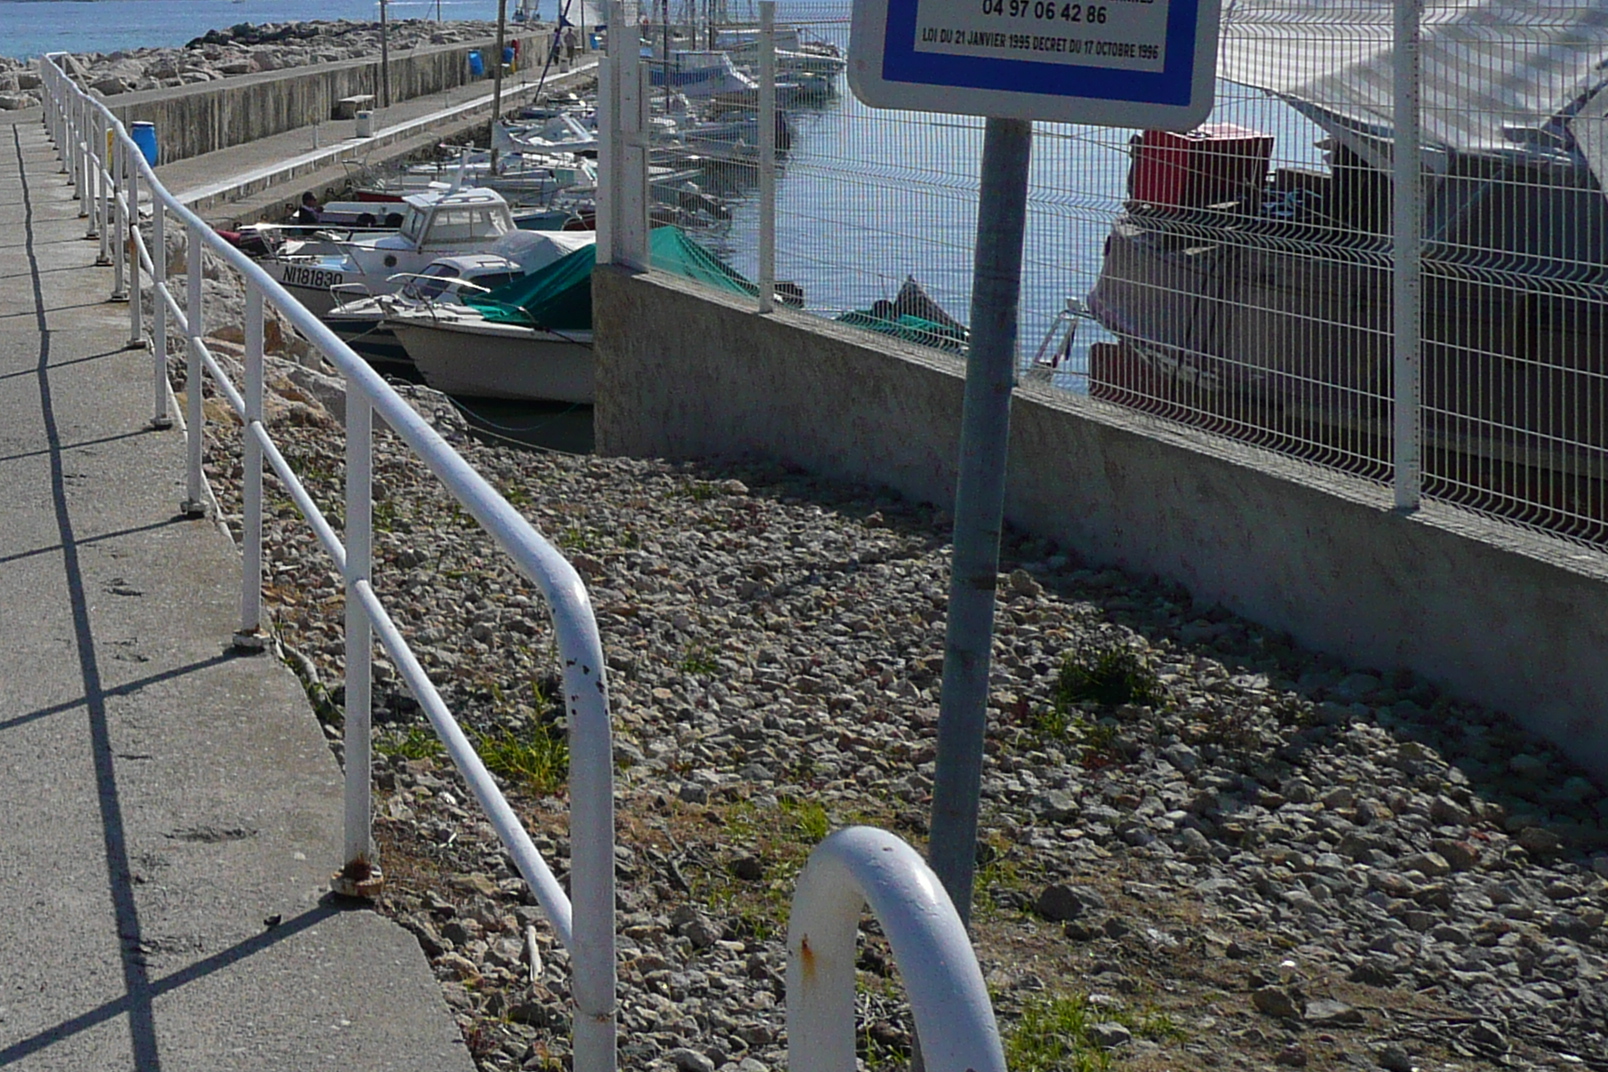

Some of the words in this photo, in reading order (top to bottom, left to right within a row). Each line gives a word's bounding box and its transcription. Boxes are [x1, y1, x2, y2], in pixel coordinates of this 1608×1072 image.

[1009, 0, 1030, 18] 97
[1034, 1, 1056, 20] 06
[1060, 3, 1082, 22] 42
[1086, 5, 1107, 24] 86
[922, 27, 938, 42] LOI
[940, 29, 953, 44] DU
[955, 30, 966, 45] 21
[967, 30, 1006, 48] JANVIER
[1009, 33, 1031, 49] 1995
[1033, 35, 1067, 53] DECRET
[1069, 38, 1082, 54] DU
[1084, 39, 1094, 55] 17
[1095, 40, 1136, 59] OCTOBRE
[1138, 43, 1160, 60] 1996
